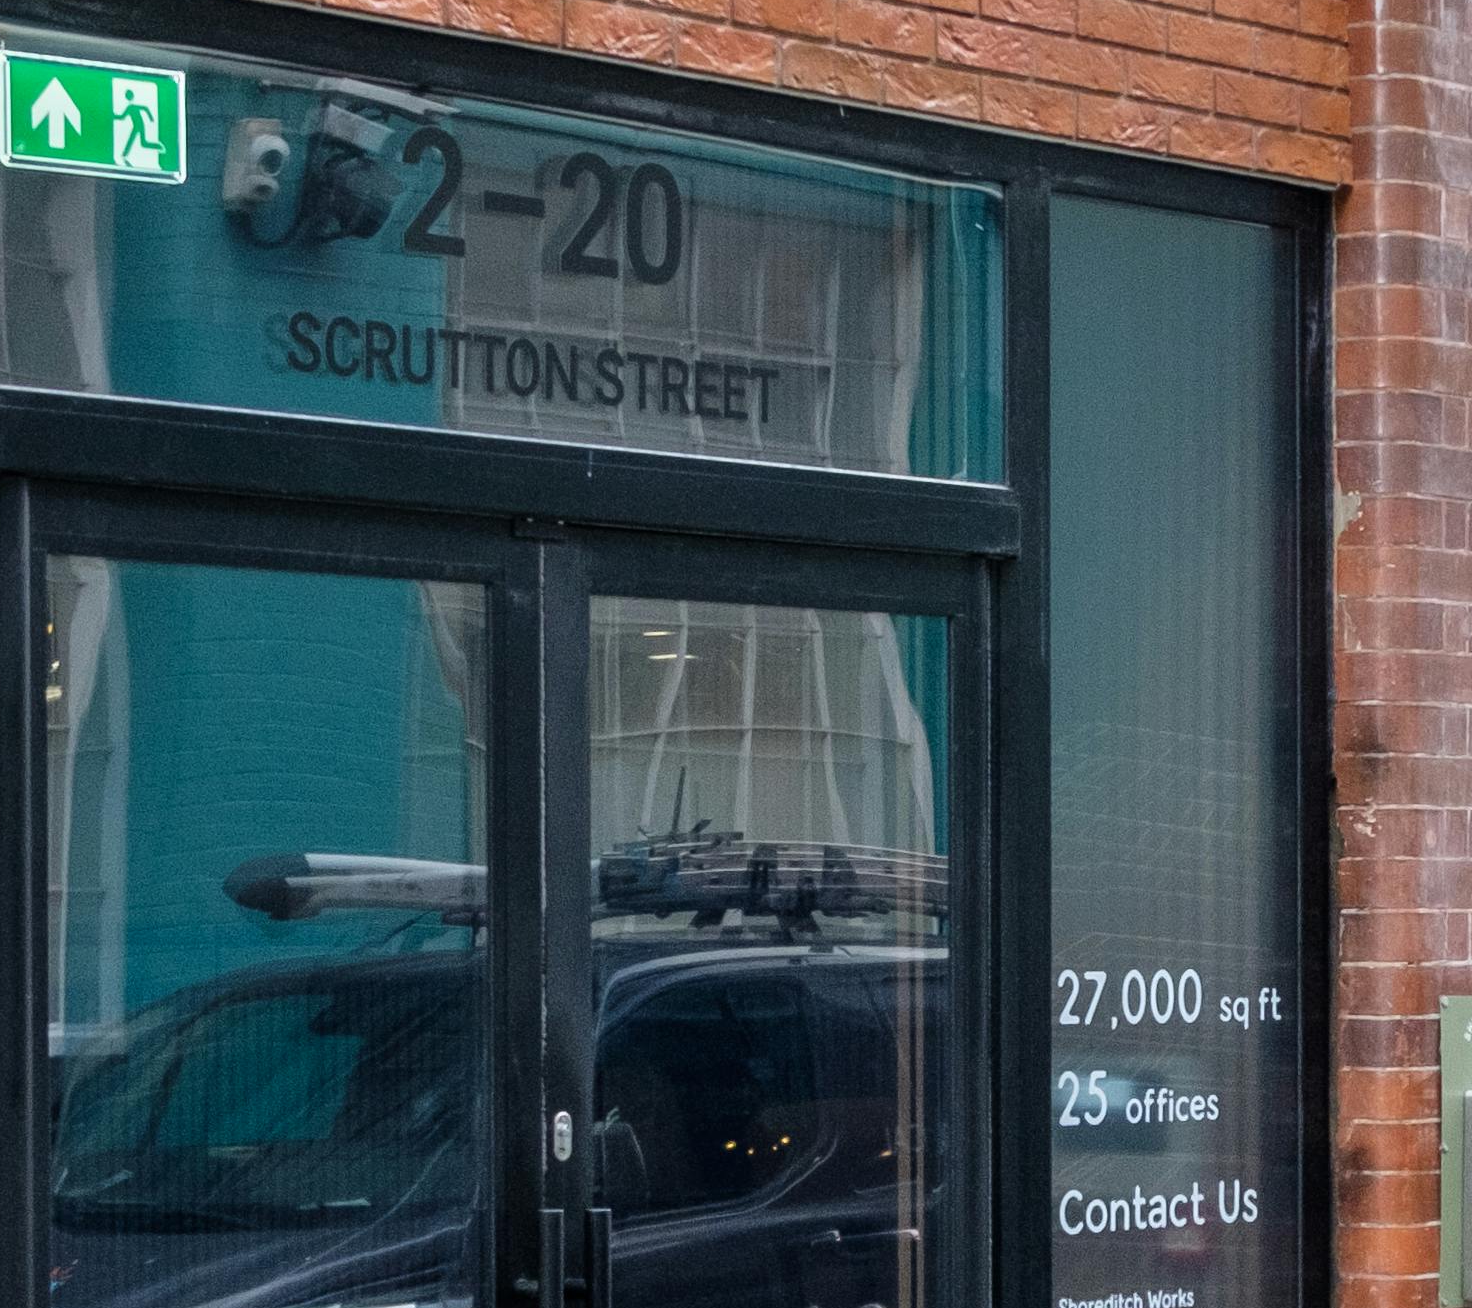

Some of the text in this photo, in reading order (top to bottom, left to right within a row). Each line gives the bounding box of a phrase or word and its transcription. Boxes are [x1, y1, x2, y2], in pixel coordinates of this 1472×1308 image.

[287, 311, 780, 423] SCRUTTON STREET
[1057, 969, 1282, 1030] 27,000 sq ft
[1057, 1070, 1219, 1126] 25 offices
[1059, 1179, 1258, 1235] Contact Us
